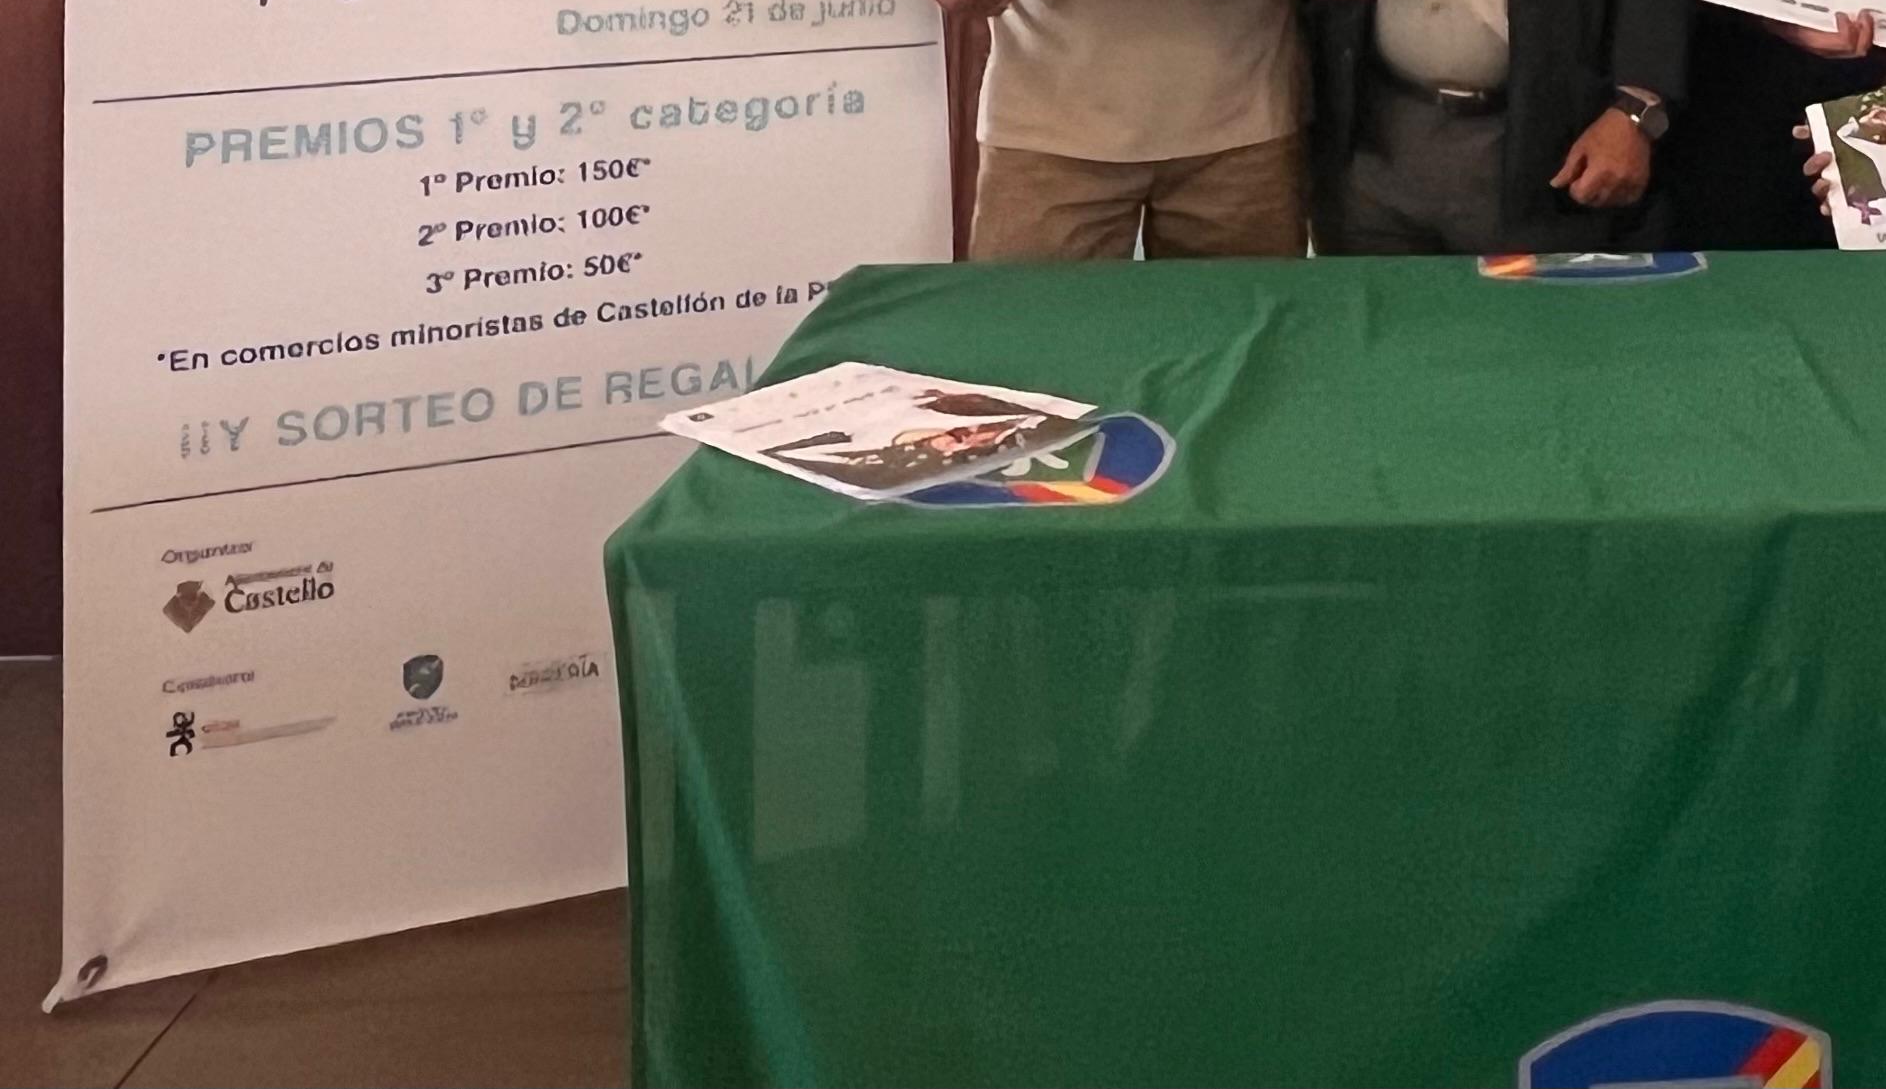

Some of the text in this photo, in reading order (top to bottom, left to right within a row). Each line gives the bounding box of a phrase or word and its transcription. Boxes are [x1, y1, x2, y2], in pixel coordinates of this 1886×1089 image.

[557, 5, 710, 36] Domingo
[722, 0, 755, 25] 21
[184, 113, 425, 169] PREMIOS
[511, 112, 537, 151] y
[455, 165, 566, 194] Premio:
[455, 214, 567, 242] Premio:
[463, 260, 575, 291] Premio:
[221, 331, 381, 369] comercios
[390, 312, 545, 348] minoristas
[553, 306, 588, 329] de
[596, 290, 726, 324] Castellón
[735, 289, 768, 310] de
[776, 284, 799, 305] la
[276, 386, 495, 448] SORTEO
[517, 375, 584, 417] DE
